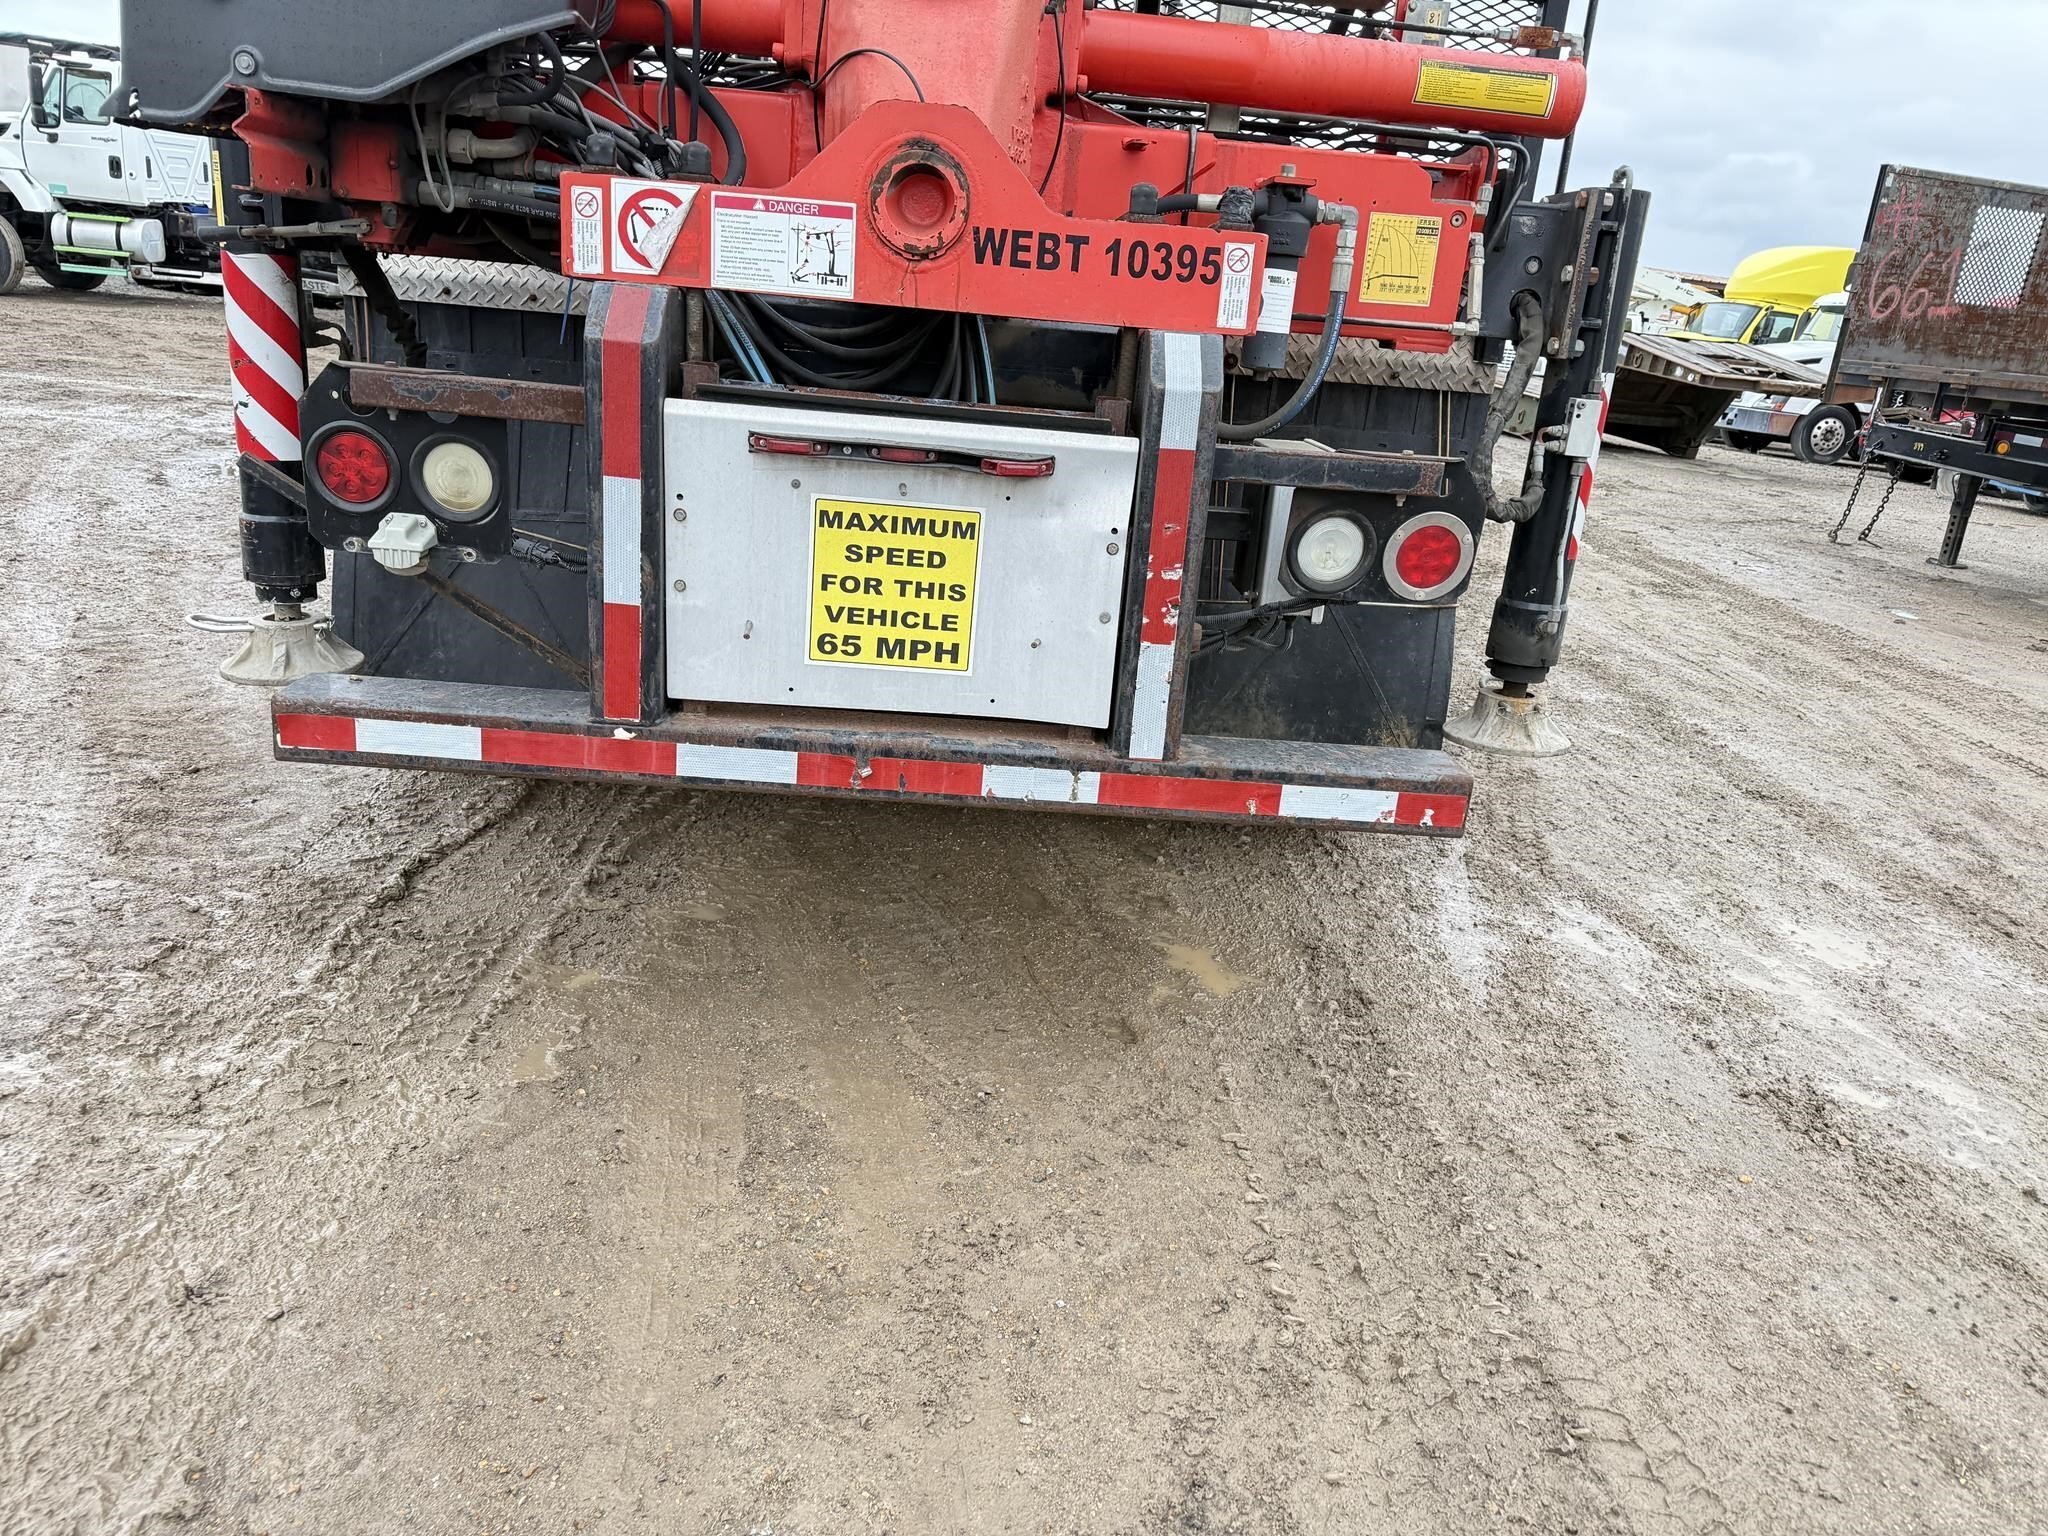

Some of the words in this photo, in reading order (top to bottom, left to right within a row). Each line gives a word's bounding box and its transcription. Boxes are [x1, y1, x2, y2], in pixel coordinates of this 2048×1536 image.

[769, 201, 819, 215] DANGER
[972, 226, 1090, 273] WEBT
[1105, 238, 1222, 285] 10395
[1869, 248, 1962, 319] 661
[818, 509, 976, 540] MAXIMUM
[844, 544, 947, 569] SPEED
[820, 574, 883, 596] FOR
[894, 579, 967, 602] THIS
[824, 605, 959, 632] VEHICLE
[816, 633, 862, 657] 65
[876, 637, 960, 664] MPH
